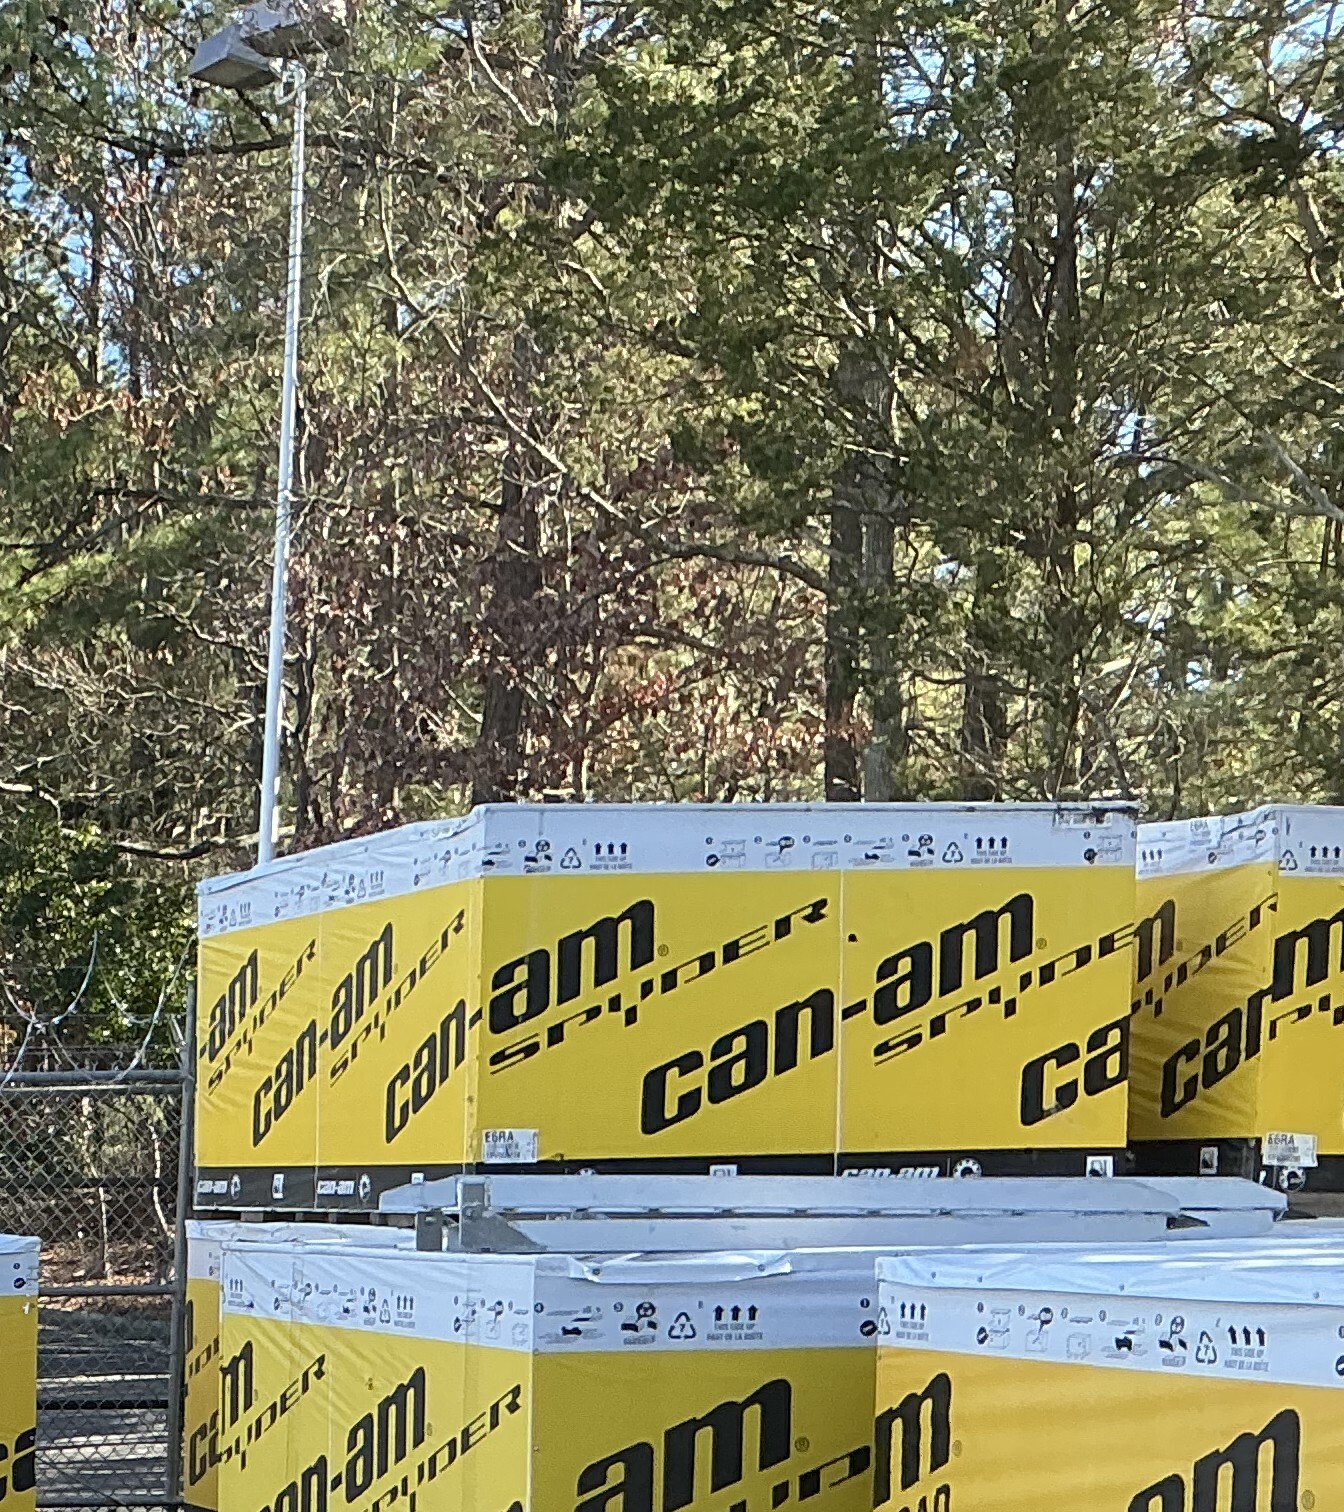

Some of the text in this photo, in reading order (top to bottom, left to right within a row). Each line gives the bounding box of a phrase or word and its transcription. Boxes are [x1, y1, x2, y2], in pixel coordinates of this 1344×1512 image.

[199, 948, 258, 1063] -am
[253, 921, 393, 1148] can-am
[329, 908, 465, 1088] SPYDER
[489, 897, 828, 1075] SPYDER
[641, 893, 1034, 1135] can-am
[873, 922, 1134, 1067] SPYDE
[317, 1180, 355, 1195] can-am
